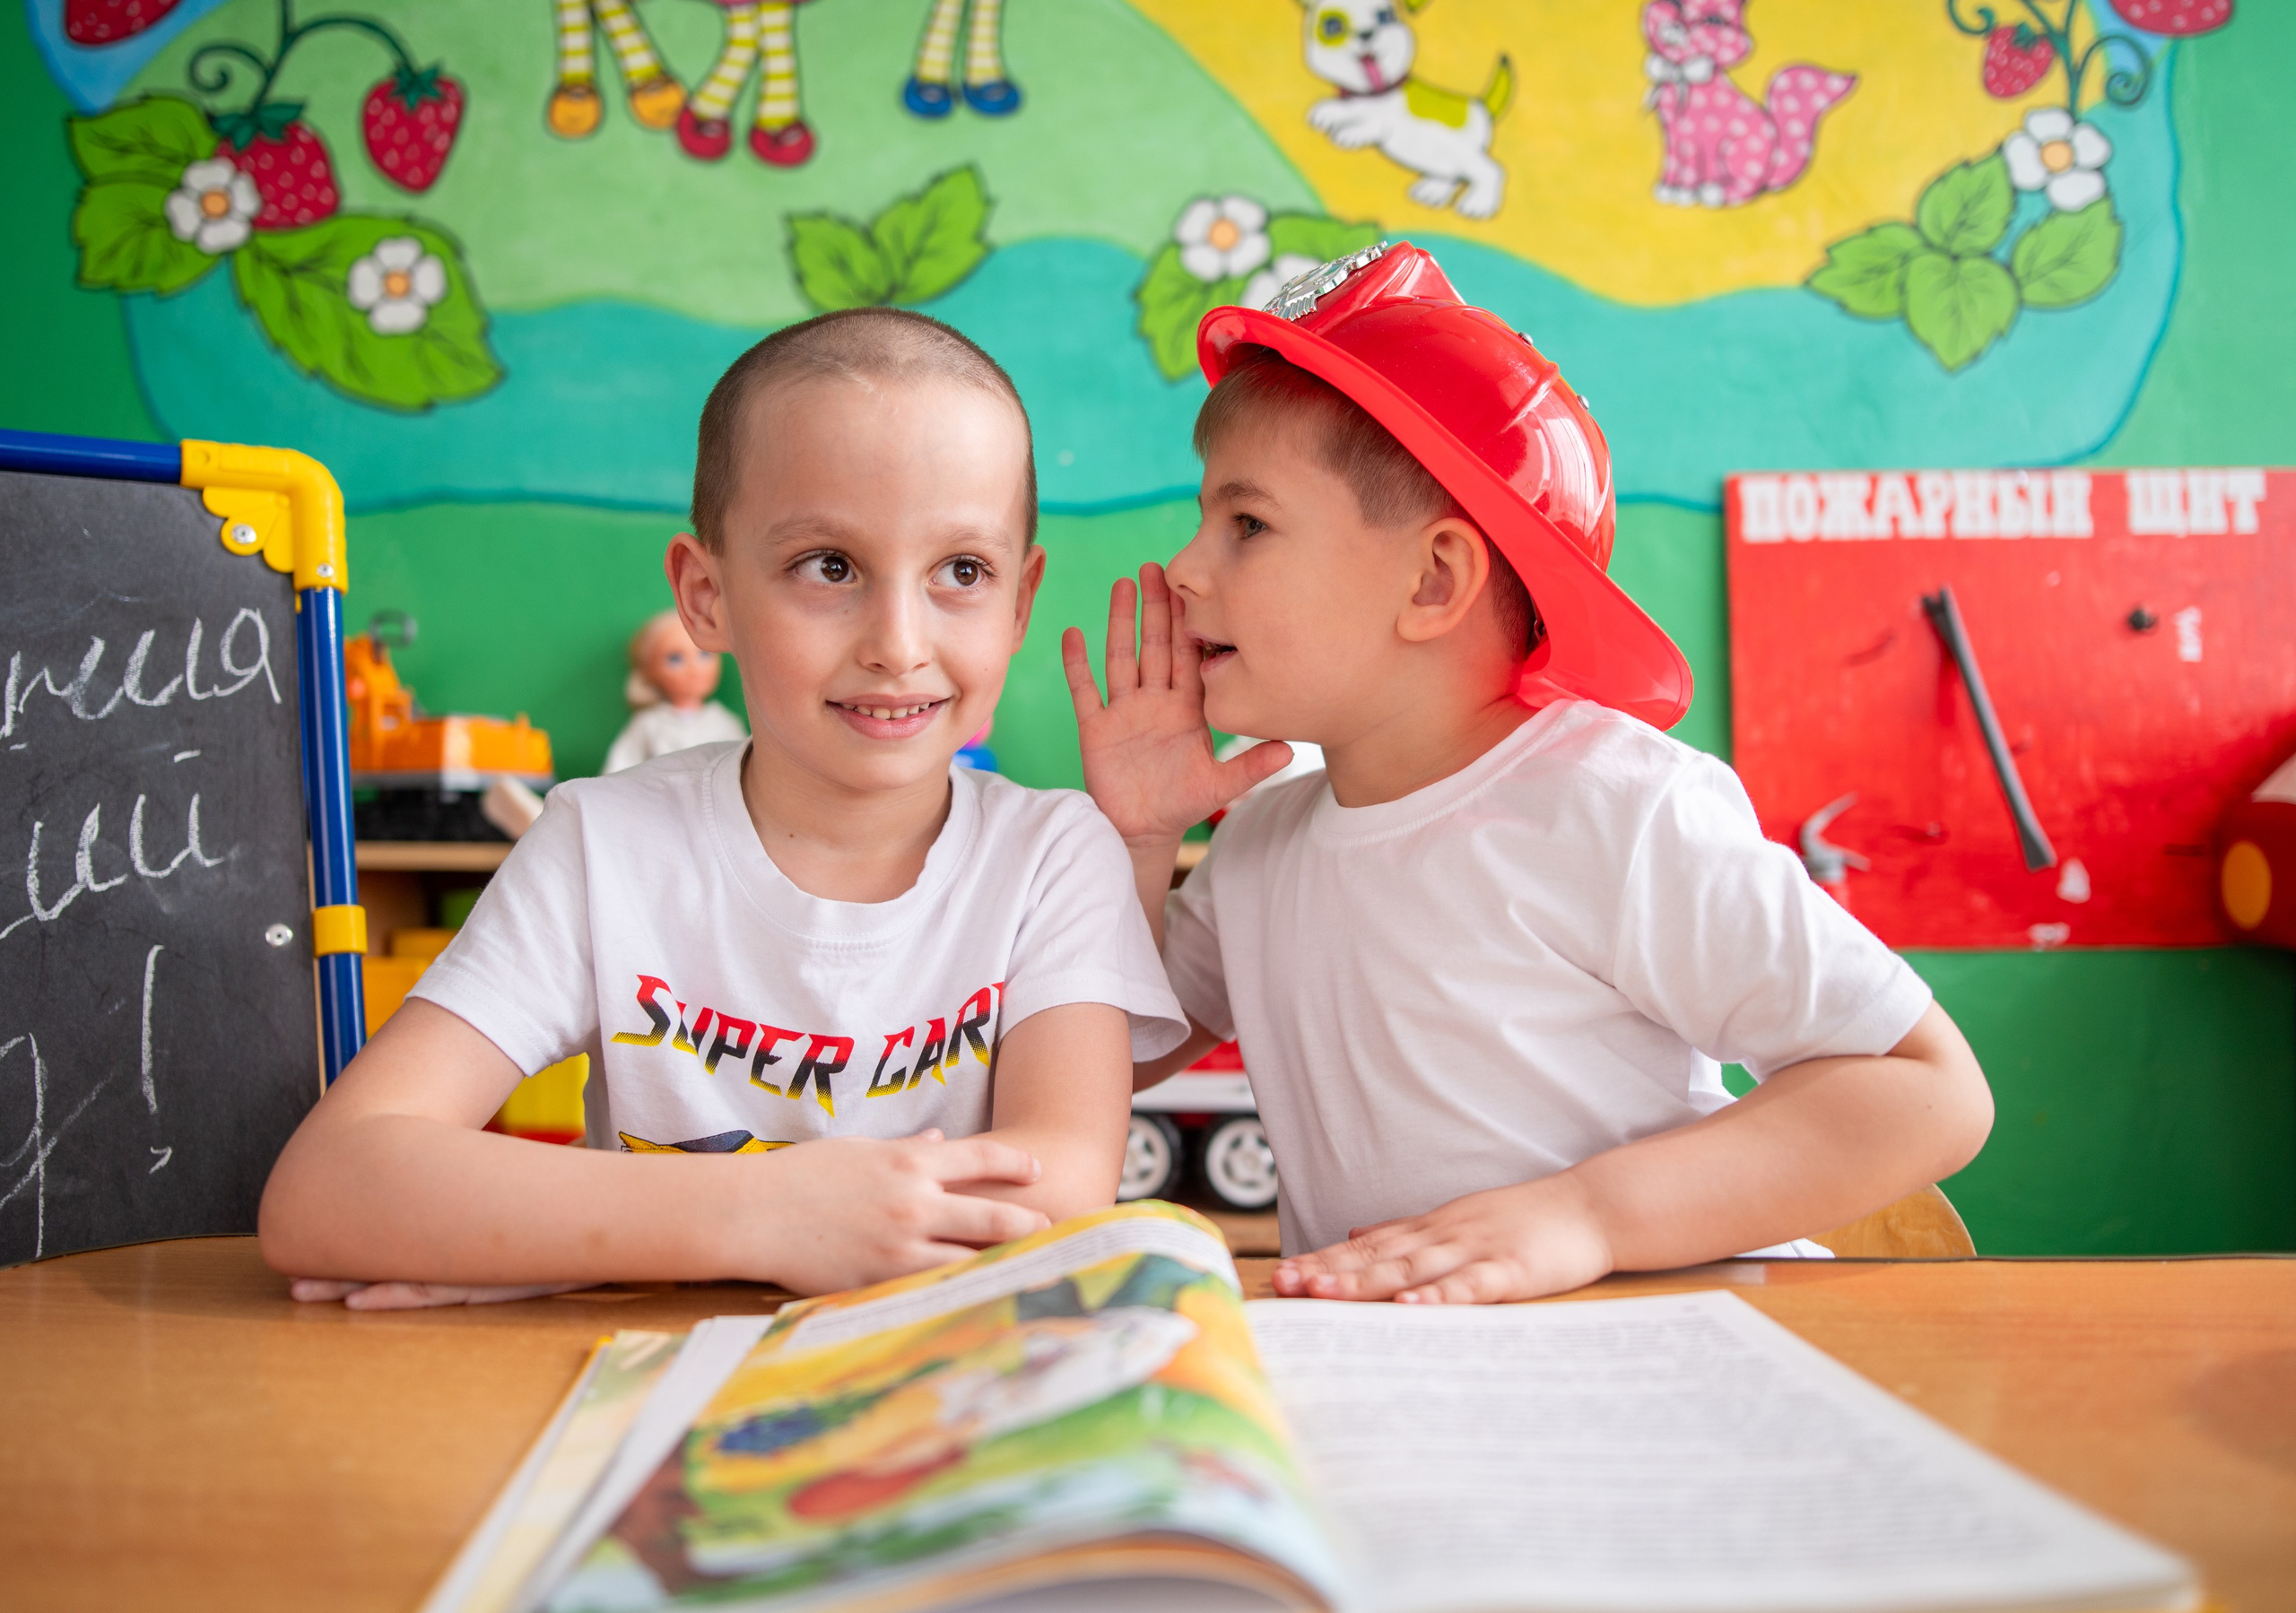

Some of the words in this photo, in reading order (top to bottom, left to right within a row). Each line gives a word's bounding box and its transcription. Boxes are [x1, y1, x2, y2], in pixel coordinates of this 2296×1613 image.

[2126, 471, 2266, 539] ЩИТ
[611, 974, 856, 1119] SUPER
[865, 981, 1004, 1098] CAR
